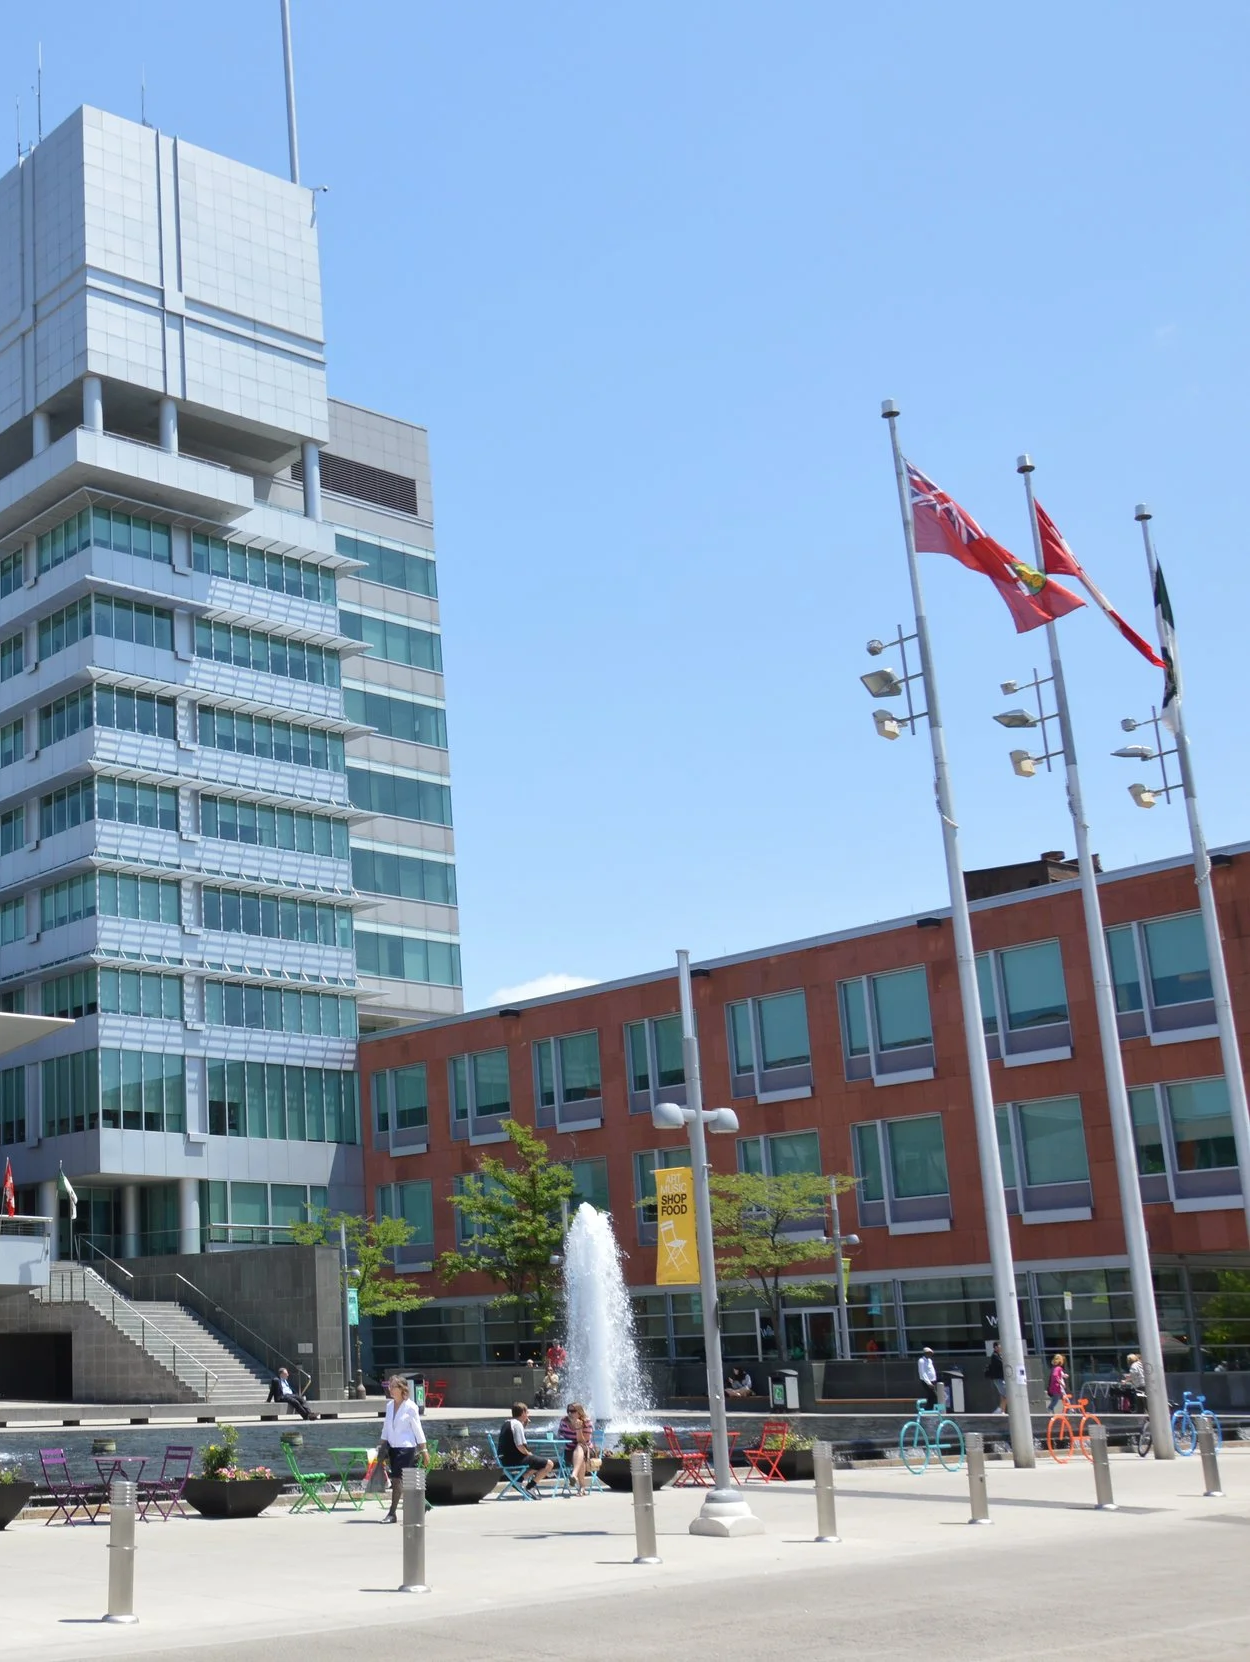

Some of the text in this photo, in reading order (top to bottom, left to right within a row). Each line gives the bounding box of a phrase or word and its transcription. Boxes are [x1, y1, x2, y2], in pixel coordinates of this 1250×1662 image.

[665, 1174, 682, 1184] ART
[660, 1182, 687, 1195] MUSIC
[661, 1193, 687, 1205] SHOP
[661, 1204, 688, 1216] FOOD
